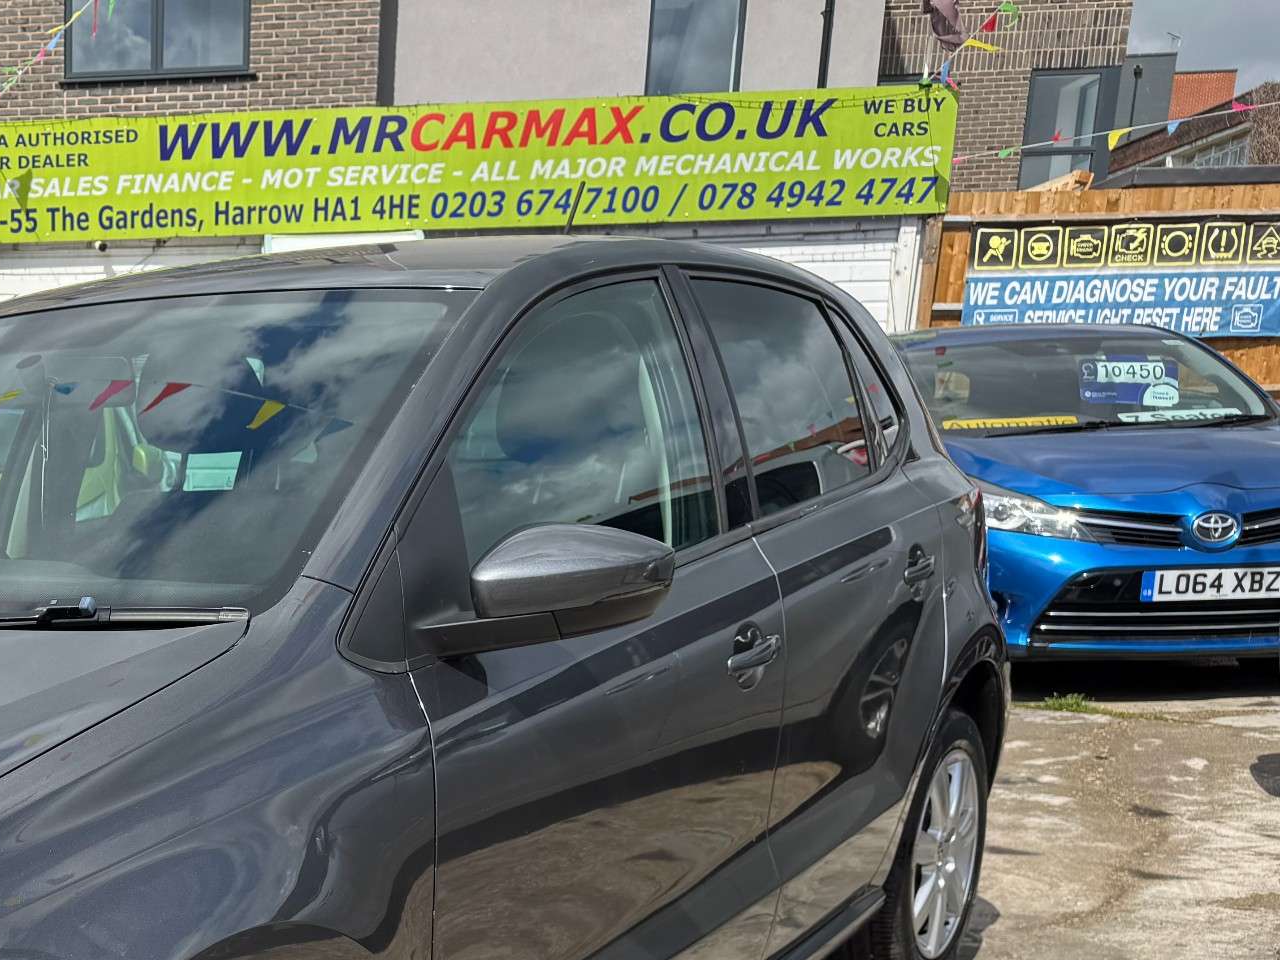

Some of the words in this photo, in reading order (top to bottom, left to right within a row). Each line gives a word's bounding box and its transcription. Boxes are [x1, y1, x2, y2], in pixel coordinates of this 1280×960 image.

[863, 99, 896, 115] WE
[903, 97, 946, 114] BUY
[15, 129, 139, 147] AUTHORISED
[158, 97, 838, 161] WWW.MRCARMAX.CO.UK
[873, 120, 929, 138] CARS
[17, 153, 89, 169] DEALER
[29, 175, 108, 197] SALES
[115, 171, 234, 194] FINANCE
[260, 168, 322, 189] MOT
[326, 163, 442, 186] SERVICE
[470, 158, 520, 182] ALL
[530, 155, 625, 180] MAJOR
[635, 150, 823, 177] MECHANICAL
[833, 145, 942, 170] WORKS
[47, 206, 90, 232] The
[97, 202, 205, 231] Gardens,
[214, 199, 303, 226] Harrow
[313, 195, 362, 222] HA1
[371, 193, 420, 219] 4HE
[430, 188, 505, 219] 0203
[516, 188, 571, 216] 674
[582, 184, 660, 214] 7100
[667, 182, 688, 217] /
[698, 182, 757, 211] 078
[767, 179, 849, 208] 4942
[855, 176, 939, 206] 4747
[1114, 254, 1144, 262] CHECK
[970, 282, 1001, 306] WE
[1004, 280, 1053, 304] CAN
[1057, 278, 1159, 304] DIAGNOSE
[1163, 276, 1219, 302] YOUR
[1222, 275, 1280, 300] FAULT
[1181, 306, 1223, 332] HERE
[1150, 411, 1233, 421] Seate
[1158, 571, 1223, 595] LO64
[1231, 570, 1280, 593] XBZ
